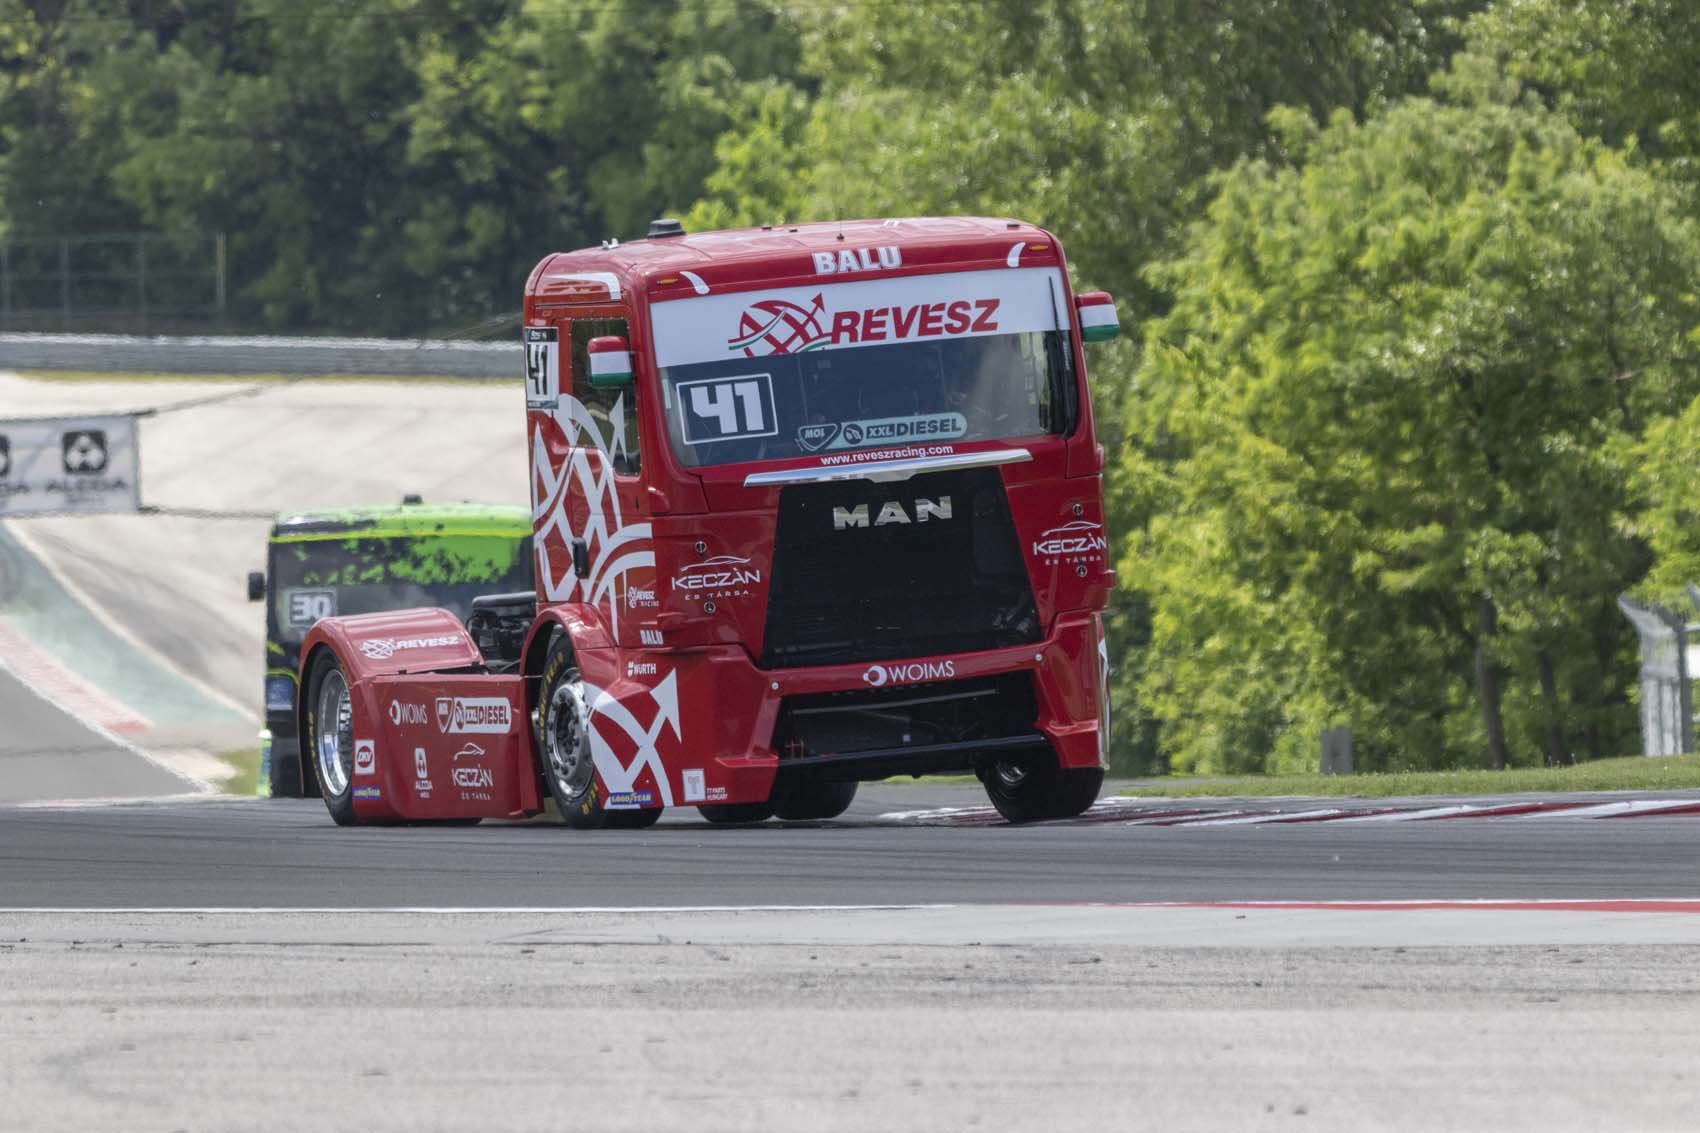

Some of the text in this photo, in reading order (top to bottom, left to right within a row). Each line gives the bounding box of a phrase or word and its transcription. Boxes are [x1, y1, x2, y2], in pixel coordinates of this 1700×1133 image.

[812, 247, 902, 275] BALU
[831, 298, 1001, 345] REVESZ
[527, 343, 548, 395] 41
[689, 380, 765, 434] 41
[820, 444, 954, 466] www.reveszracing.com
[832, 495, 953, 531] MAN
[292, 594, 331, 620] 30
[396, 636, 459, 650] REVESZ
[640, 629, 664, 645] BALU
[888, 660, 956, 683] WOIMS
[400, 703, 428, 725] WOIMS
